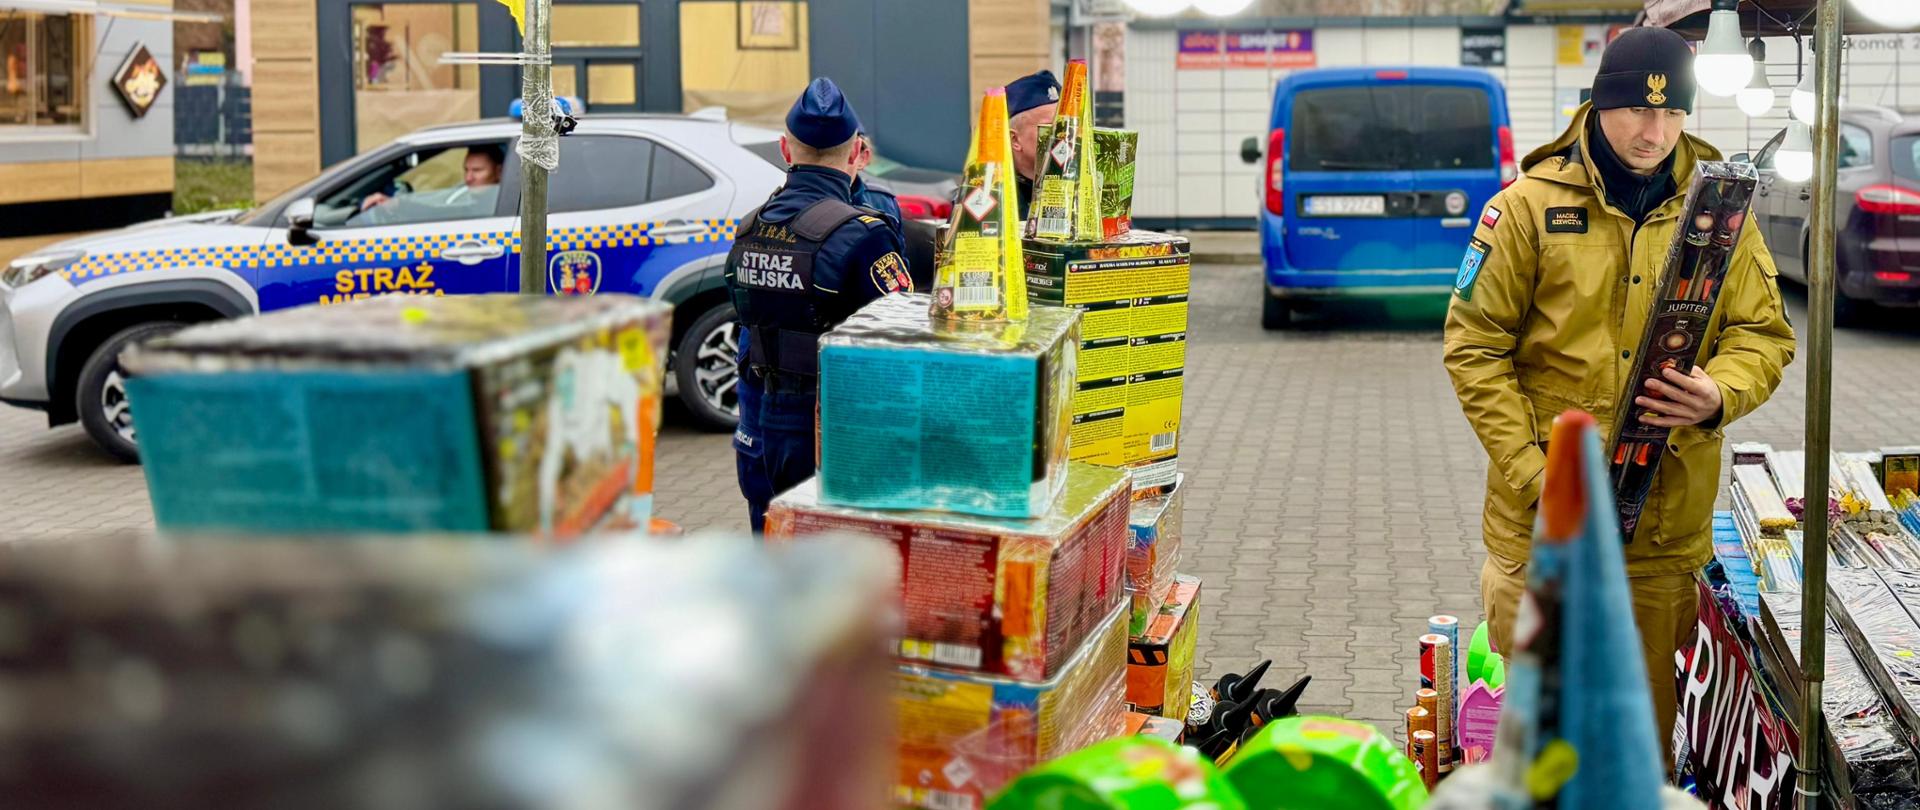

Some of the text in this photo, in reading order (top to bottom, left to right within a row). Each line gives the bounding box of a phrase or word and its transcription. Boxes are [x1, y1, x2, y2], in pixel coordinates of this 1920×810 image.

[335, 261, 434, 293] STRAŻ
[736, 267, 805, 290] MIEJSKA
[1667, 303, 1709, 315] JUPITER
